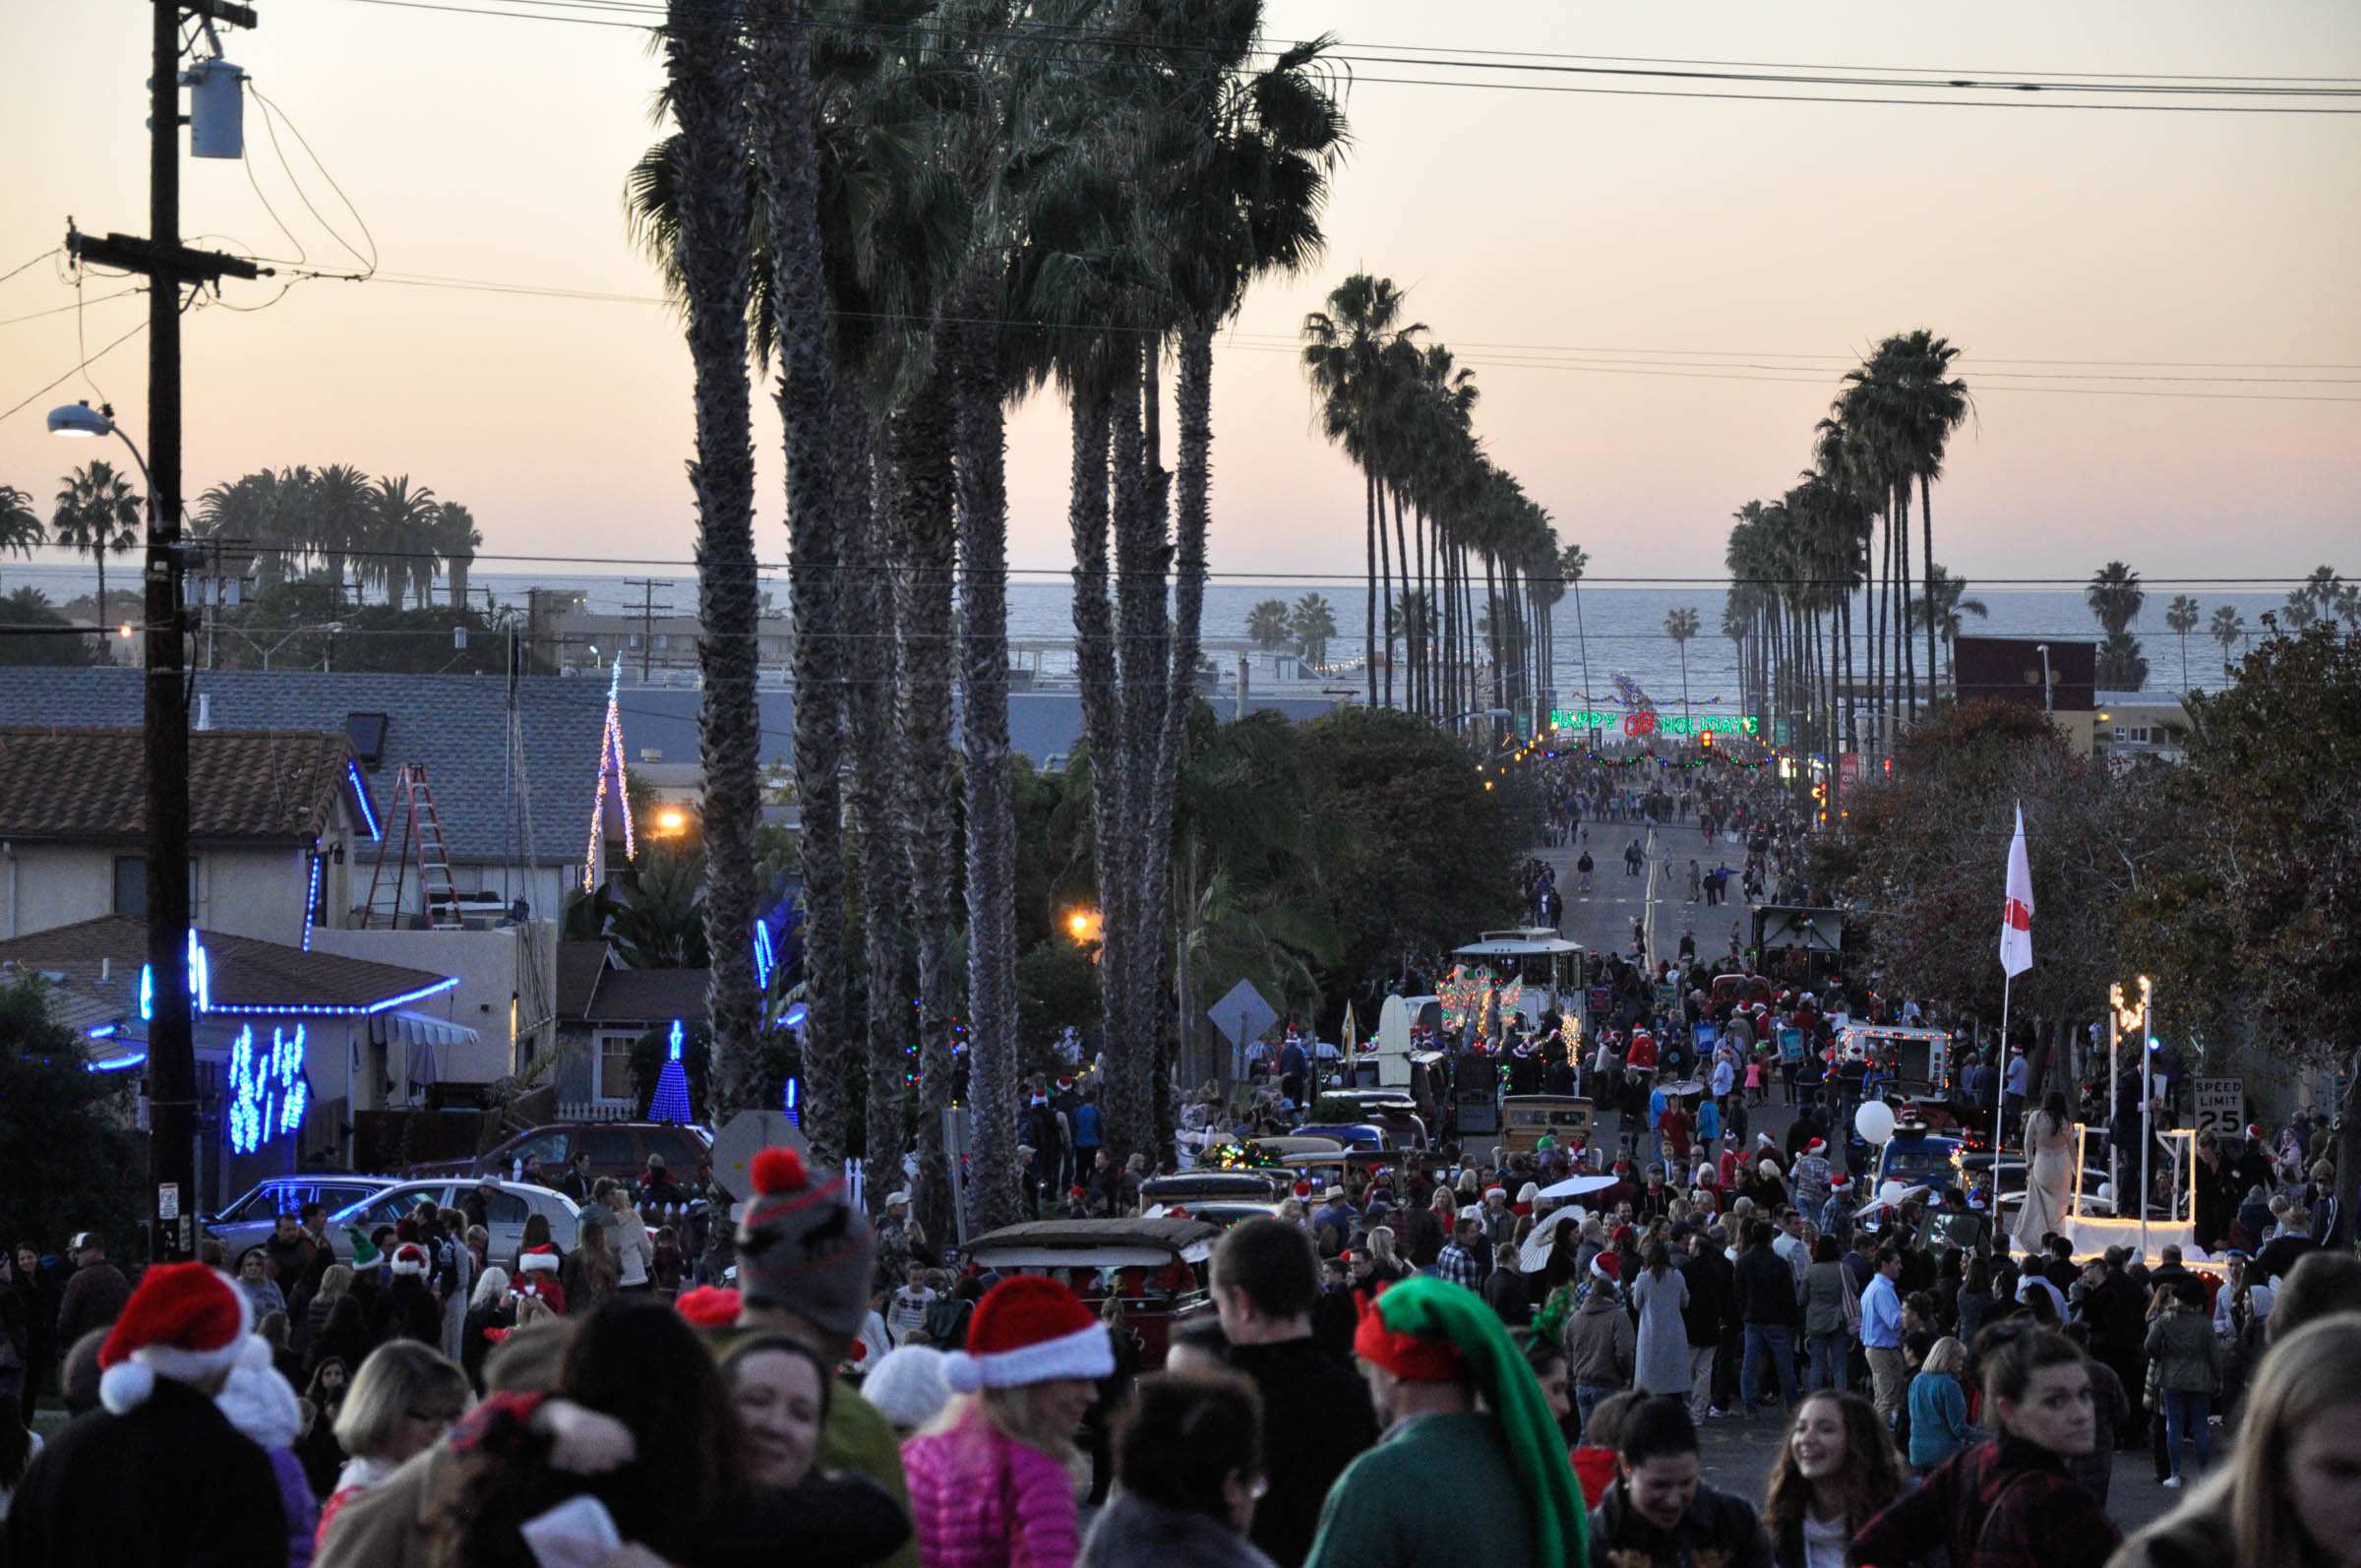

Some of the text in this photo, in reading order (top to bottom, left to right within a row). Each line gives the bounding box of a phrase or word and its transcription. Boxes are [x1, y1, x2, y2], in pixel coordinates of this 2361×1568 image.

[1551, 709, 1617, 731] HAPPY
[1624, 710, 1654, 738] OB
[1662, 714, 1758, 737] HOLIDAYS
[2196, 1081, 2242, 1092] SPEED
[2200, 1096, 2238, 1107] LIMIT
[2199, 1111, 2240, 1132] 25
